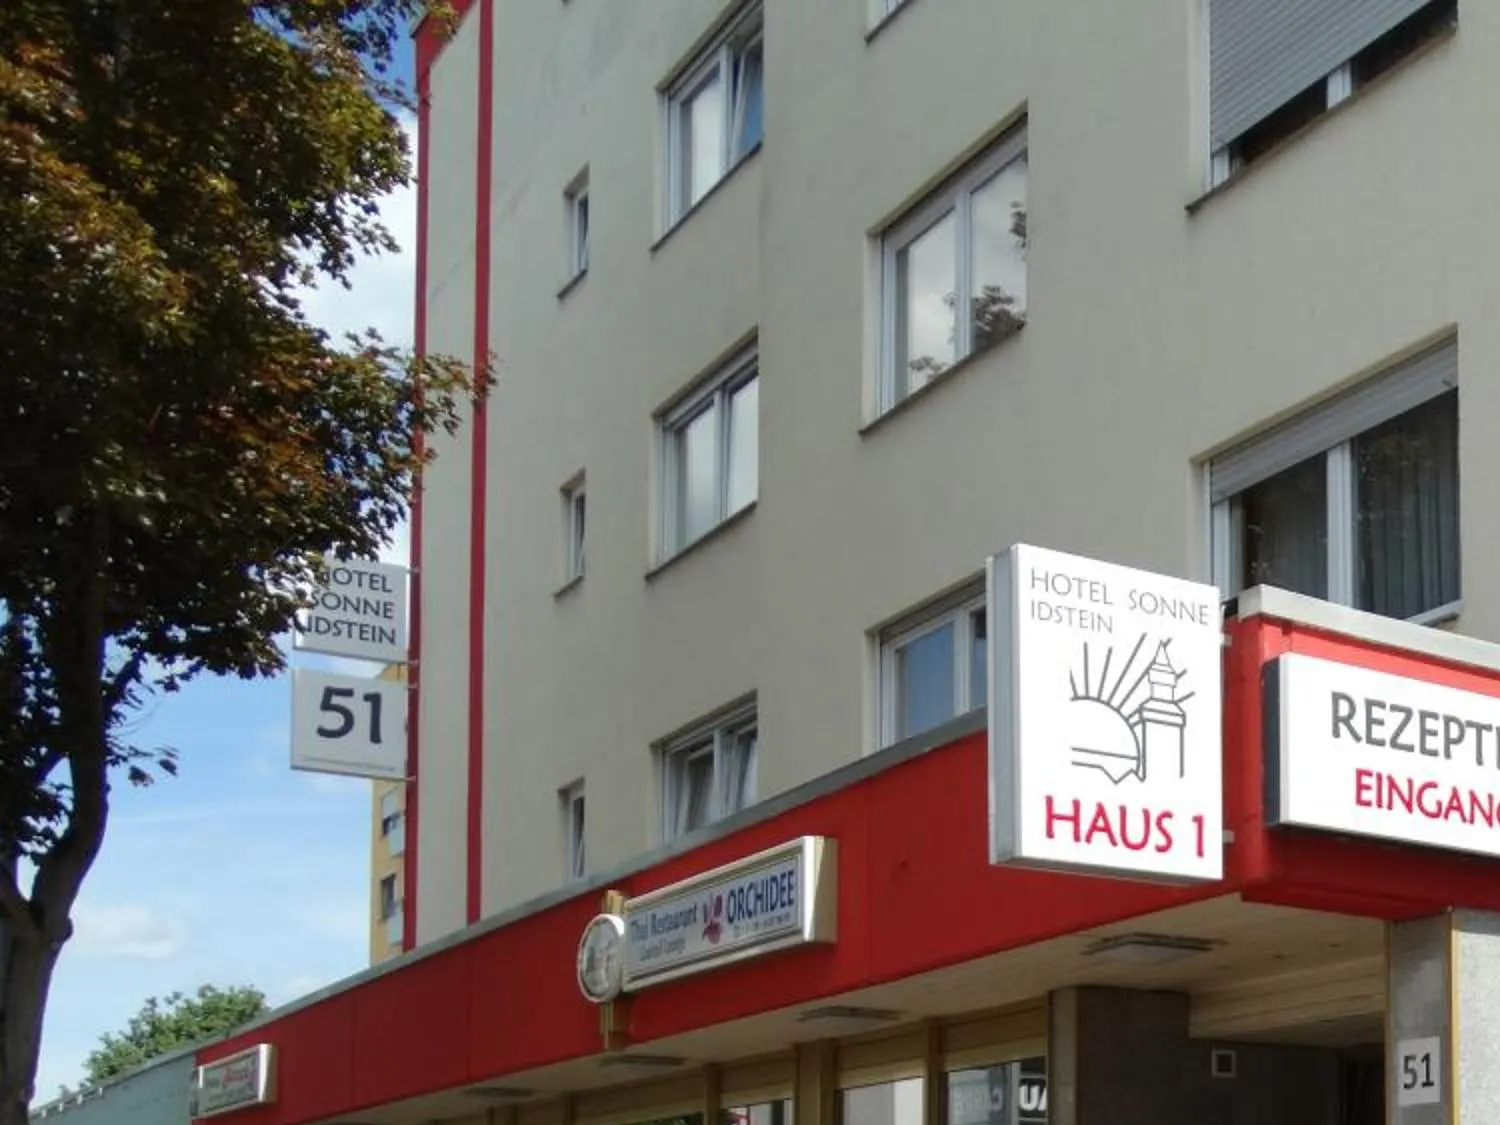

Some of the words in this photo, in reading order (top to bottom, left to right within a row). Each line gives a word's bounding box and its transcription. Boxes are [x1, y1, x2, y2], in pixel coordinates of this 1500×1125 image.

[311, 590, 395, 620] SONNE
[1029, 600, 1114, 634] IDSTEIN
[1030, 567, 1114, 606] HOTEL
[1128, 588, 1210, 627] SONNE
[307, 615, 397, 646] IDSTEIN
[316, 685, 383, 745] 51
[1044, 795, 1173, 854] HAUS
[1191, 814, 1205, 859] 1
[726, 869, 795, 924] ORCHIDEE
[1403, 1052, 1435, 1090] 51
